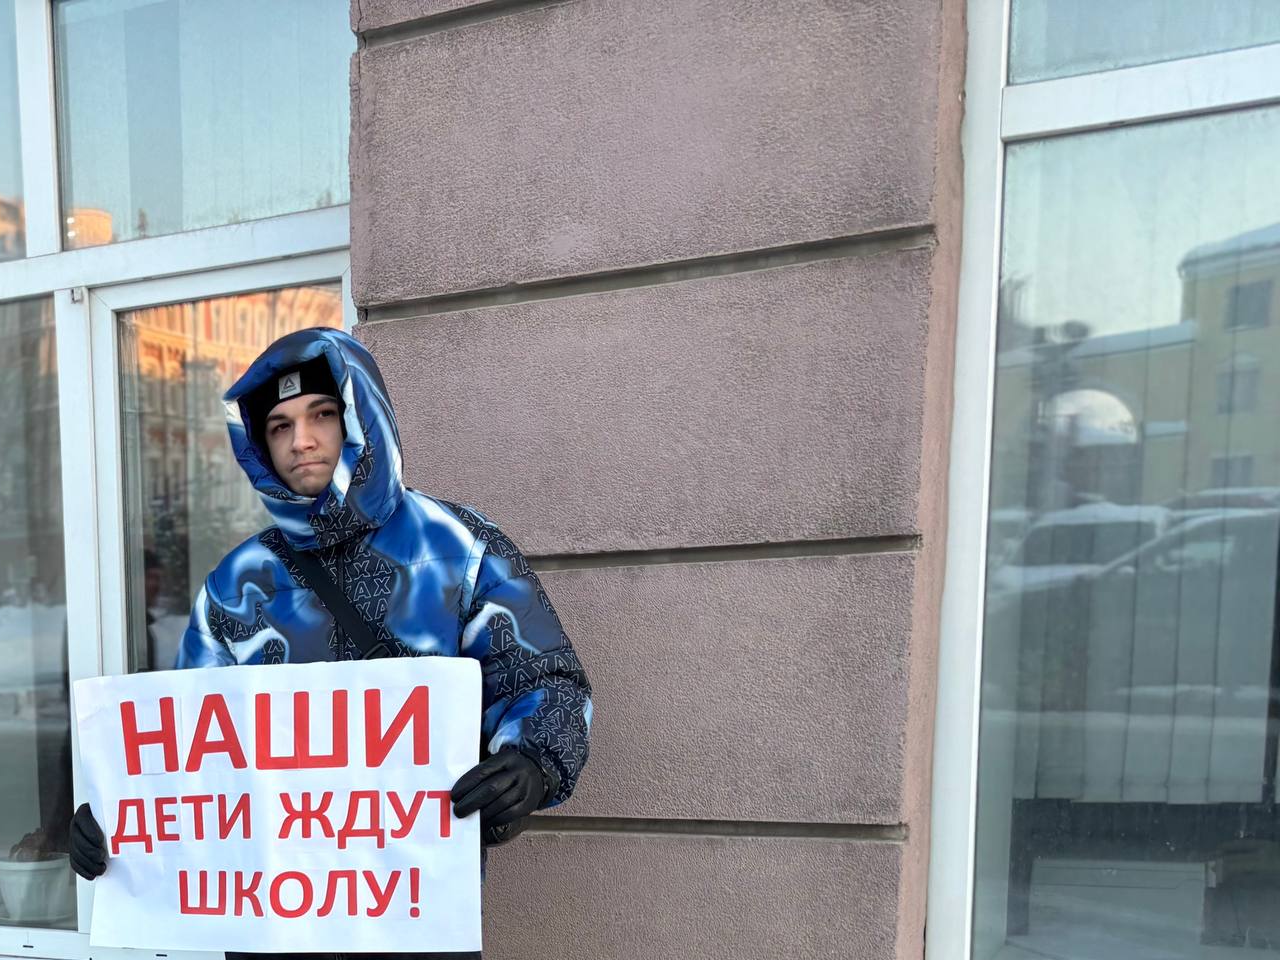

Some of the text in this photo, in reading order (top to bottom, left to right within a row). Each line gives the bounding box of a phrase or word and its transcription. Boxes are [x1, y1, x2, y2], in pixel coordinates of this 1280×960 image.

[120, 685, 430, 776] НАШИ
[111, 790, 452, 855] ДЕТИ ЖДУТ
[179, 867, 420, 919] ШКОЛУ!
